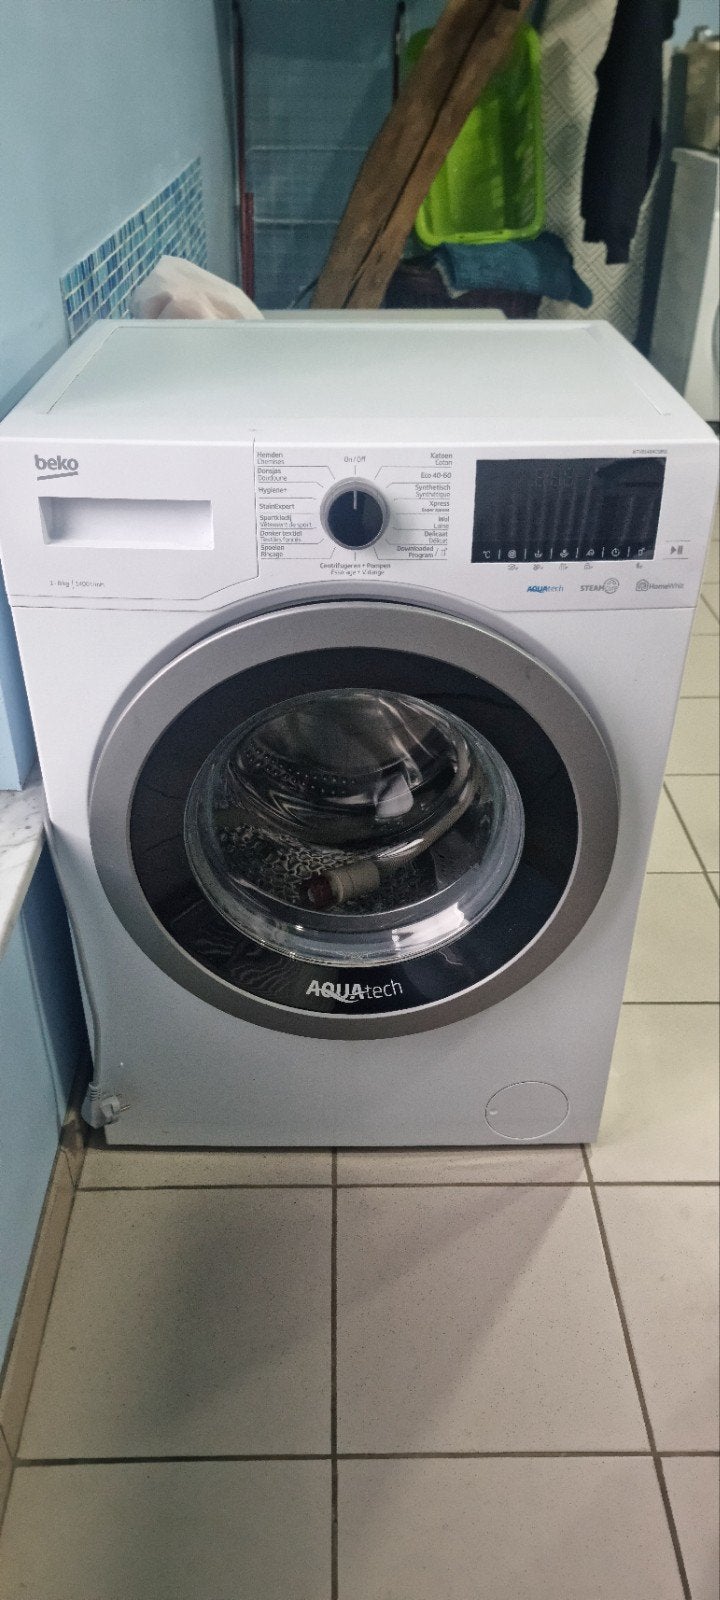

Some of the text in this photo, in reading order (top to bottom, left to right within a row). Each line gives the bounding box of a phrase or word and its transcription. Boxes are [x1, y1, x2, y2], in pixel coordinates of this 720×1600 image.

[257, 451, 284, 459] Hemden
[34, 454, 79, 471] beko
[415, 484, 451, 492] Synthetisch
[429, 500, 450, 508] Xpress
[260, 544, 285, 552] Spoelen
[408, 552, 434, 560] Program
[526, 585, 564, 594] AQUAtech
[306, 979, 404, 1004] AQUAtech
